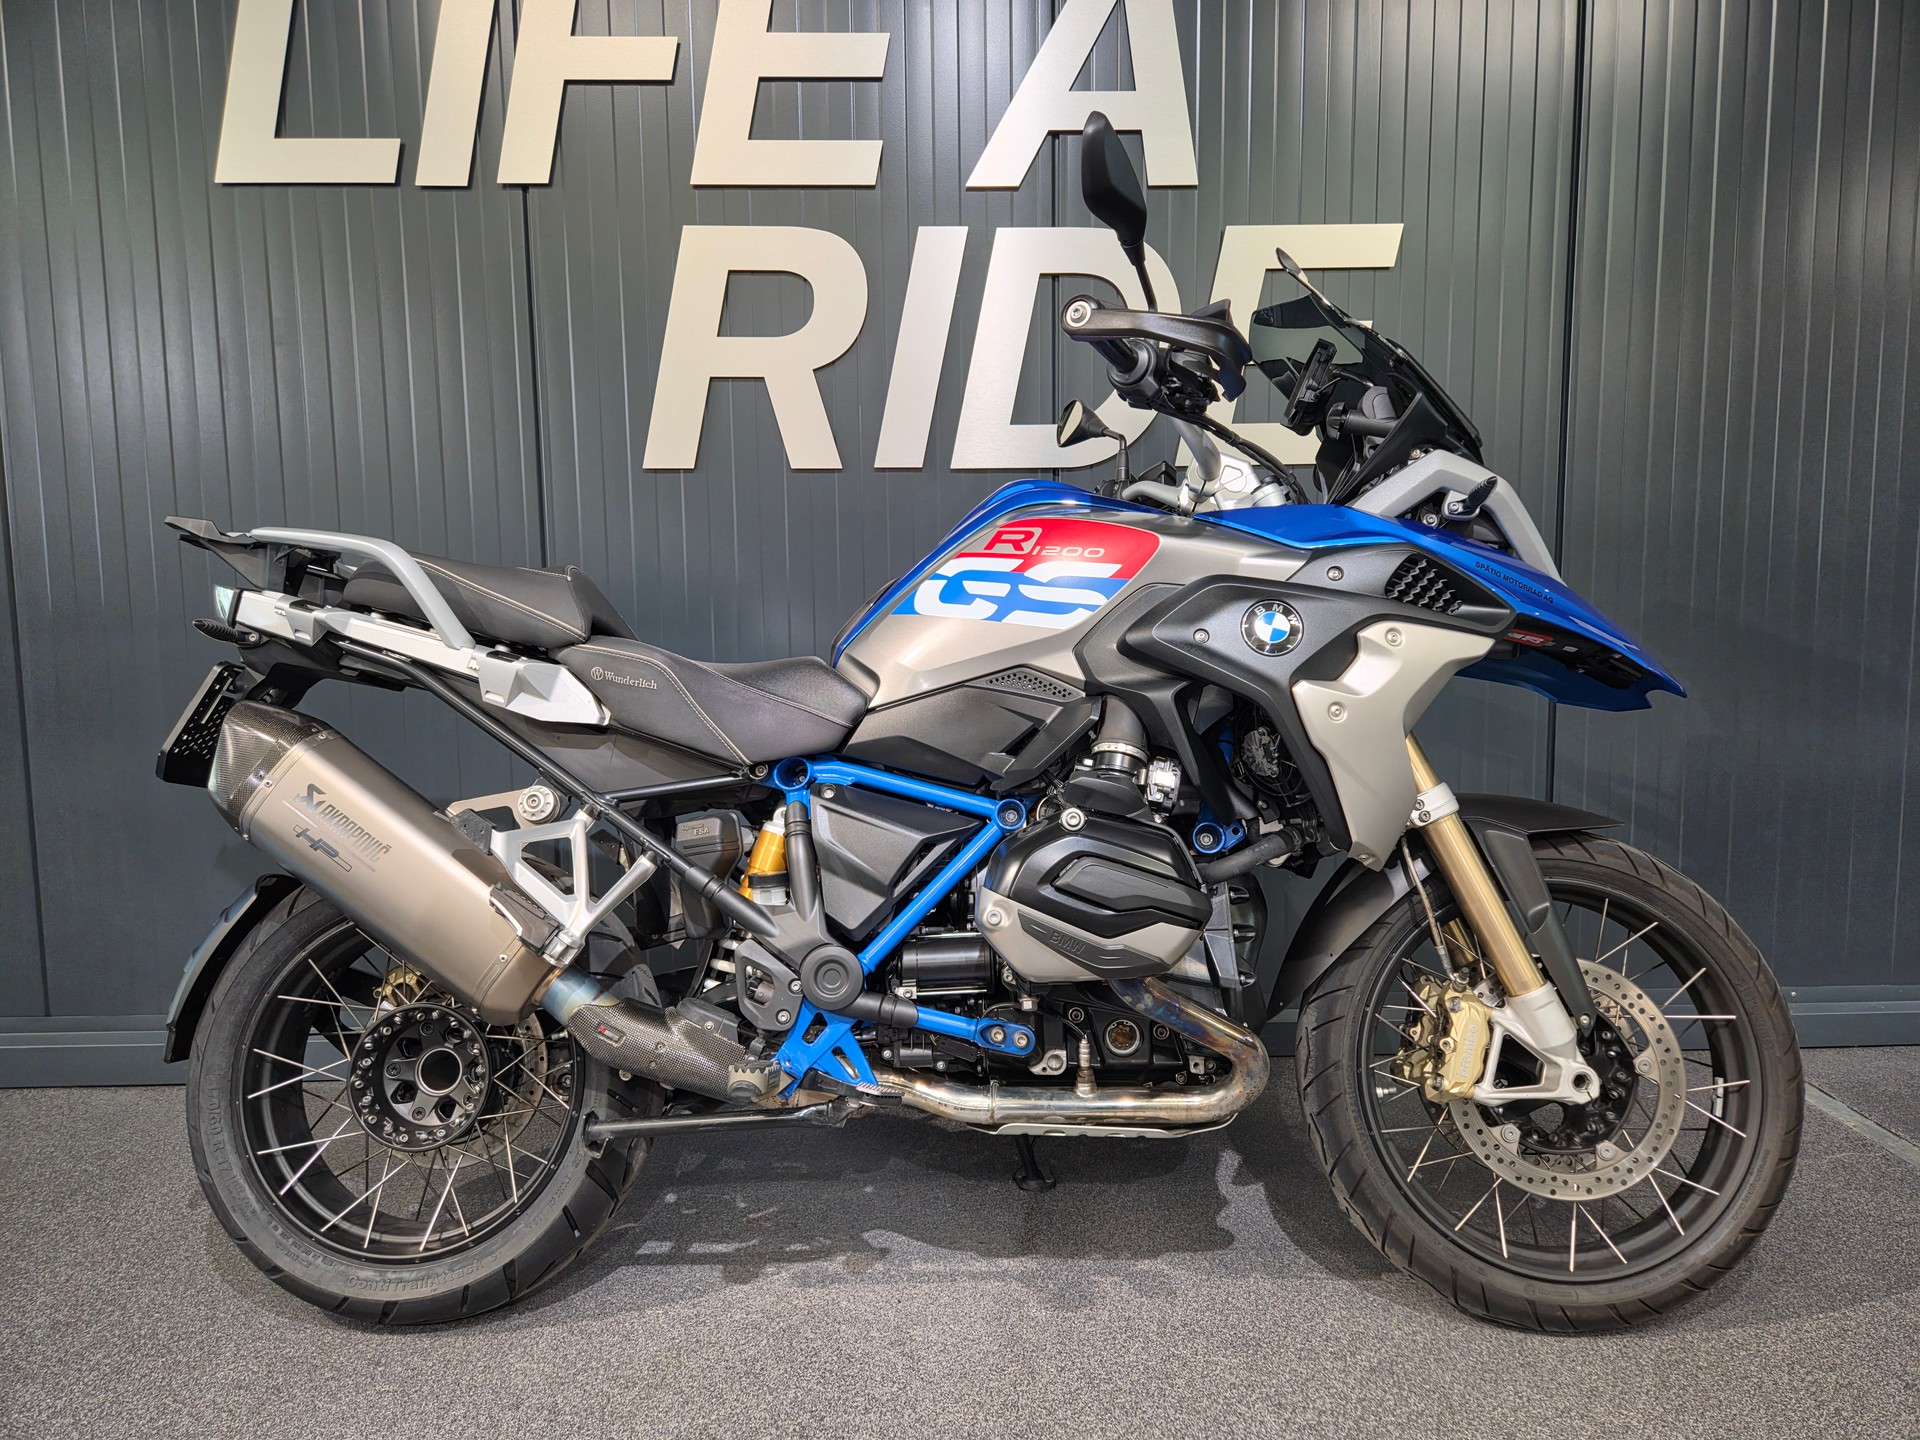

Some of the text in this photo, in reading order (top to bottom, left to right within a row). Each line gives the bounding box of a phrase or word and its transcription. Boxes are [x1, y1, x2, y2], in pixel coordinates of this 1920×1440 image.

[214, 0, 1199, 189] LIFE A
[643, 223, 1404, 470] RIDE
[1032, 546, 1105, 558] 1200
[914, 556, 1123, 630] GS
[1502, 573, 1543, 598] MOTORRAD
[1254, 603, 1301, 626] BMW
[604, 670, 658, 690] Wunderlich
[1050, 932, 1086, 955] BMW
[1456, 1023, 1478, 1078] brembo
[349, 1258, 485, 1292] ContiTrailAttack
